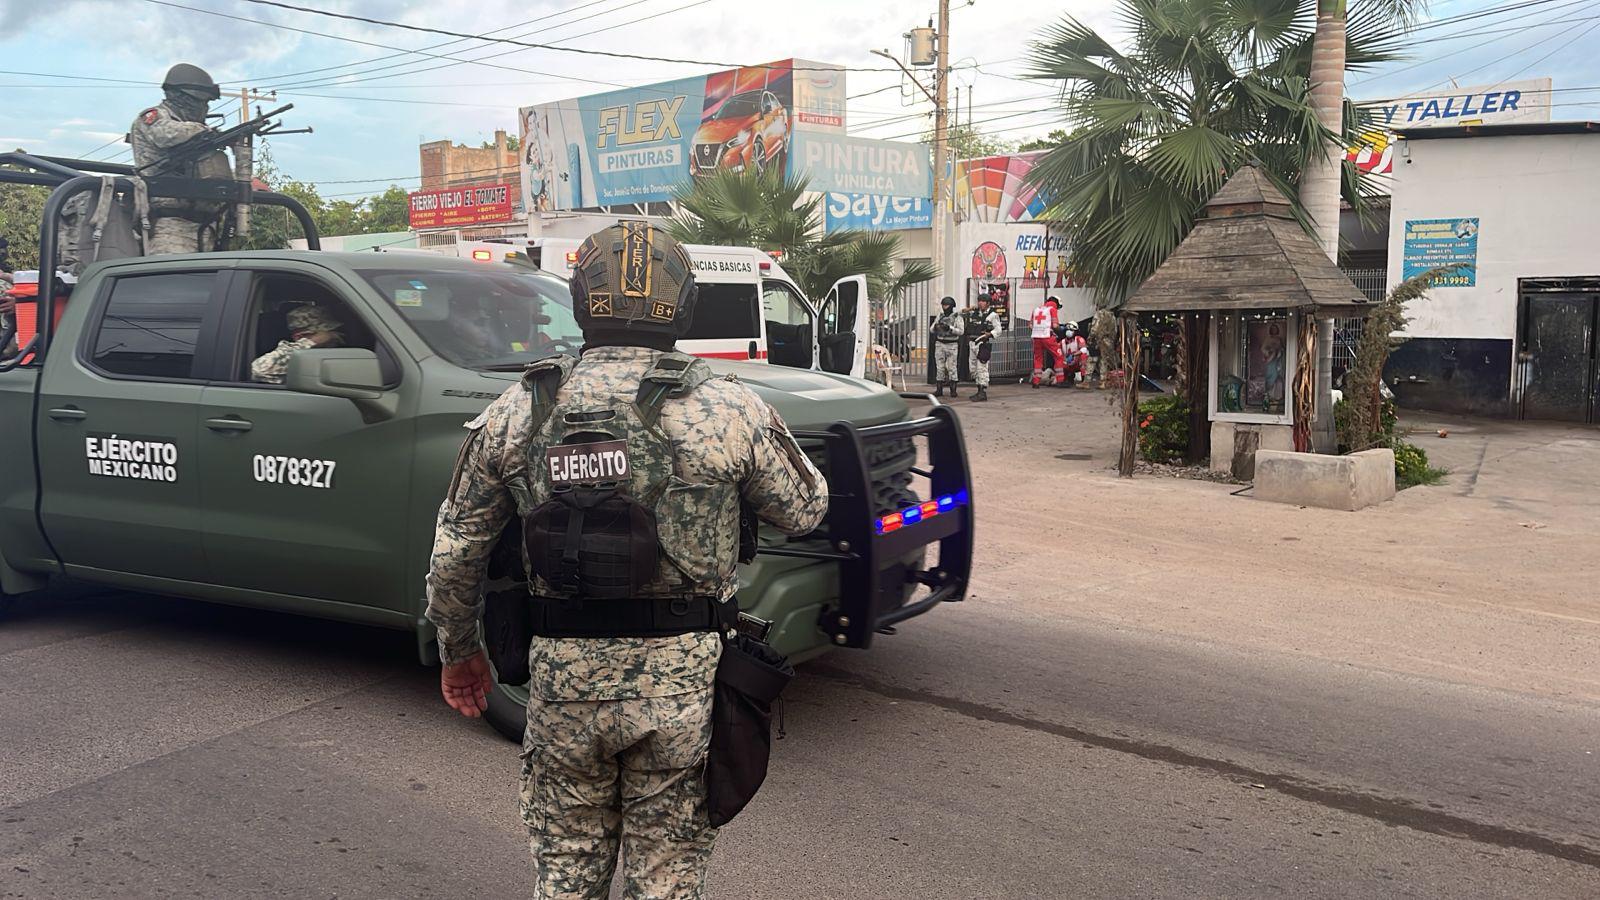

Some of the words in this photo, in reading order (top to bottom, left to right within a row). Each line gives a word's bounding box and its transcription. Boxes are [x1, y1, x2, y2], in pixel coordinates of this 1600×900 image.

[802, 112, 838, 125] PINTURAS
[1406, 90, 1521, 121] TALLER
[597, 96, 687, 148] FLEX
[607, 149, 674, 169] PINTURAS
[806, 140, 919, 175] PINTURA
[835, 173, 895, 190] VINILICA
[412, 193, 437, 211] FIERRO
[439, 192, 461, 209] VIEJO
[464, 190, 473, 207] EL
[475, 187, 507, 206] TOMATE
[692, 260, 718, 271] NCIAS
[720, 261, 752, 272] BASICAS
[86, 434, 177, 465] EJÉRCITO
[88, 458, 177, 482] MEXICANO
[253, 454, 336, 488] 0878327
[549, 449, 627, 481] EJÉRCITO
